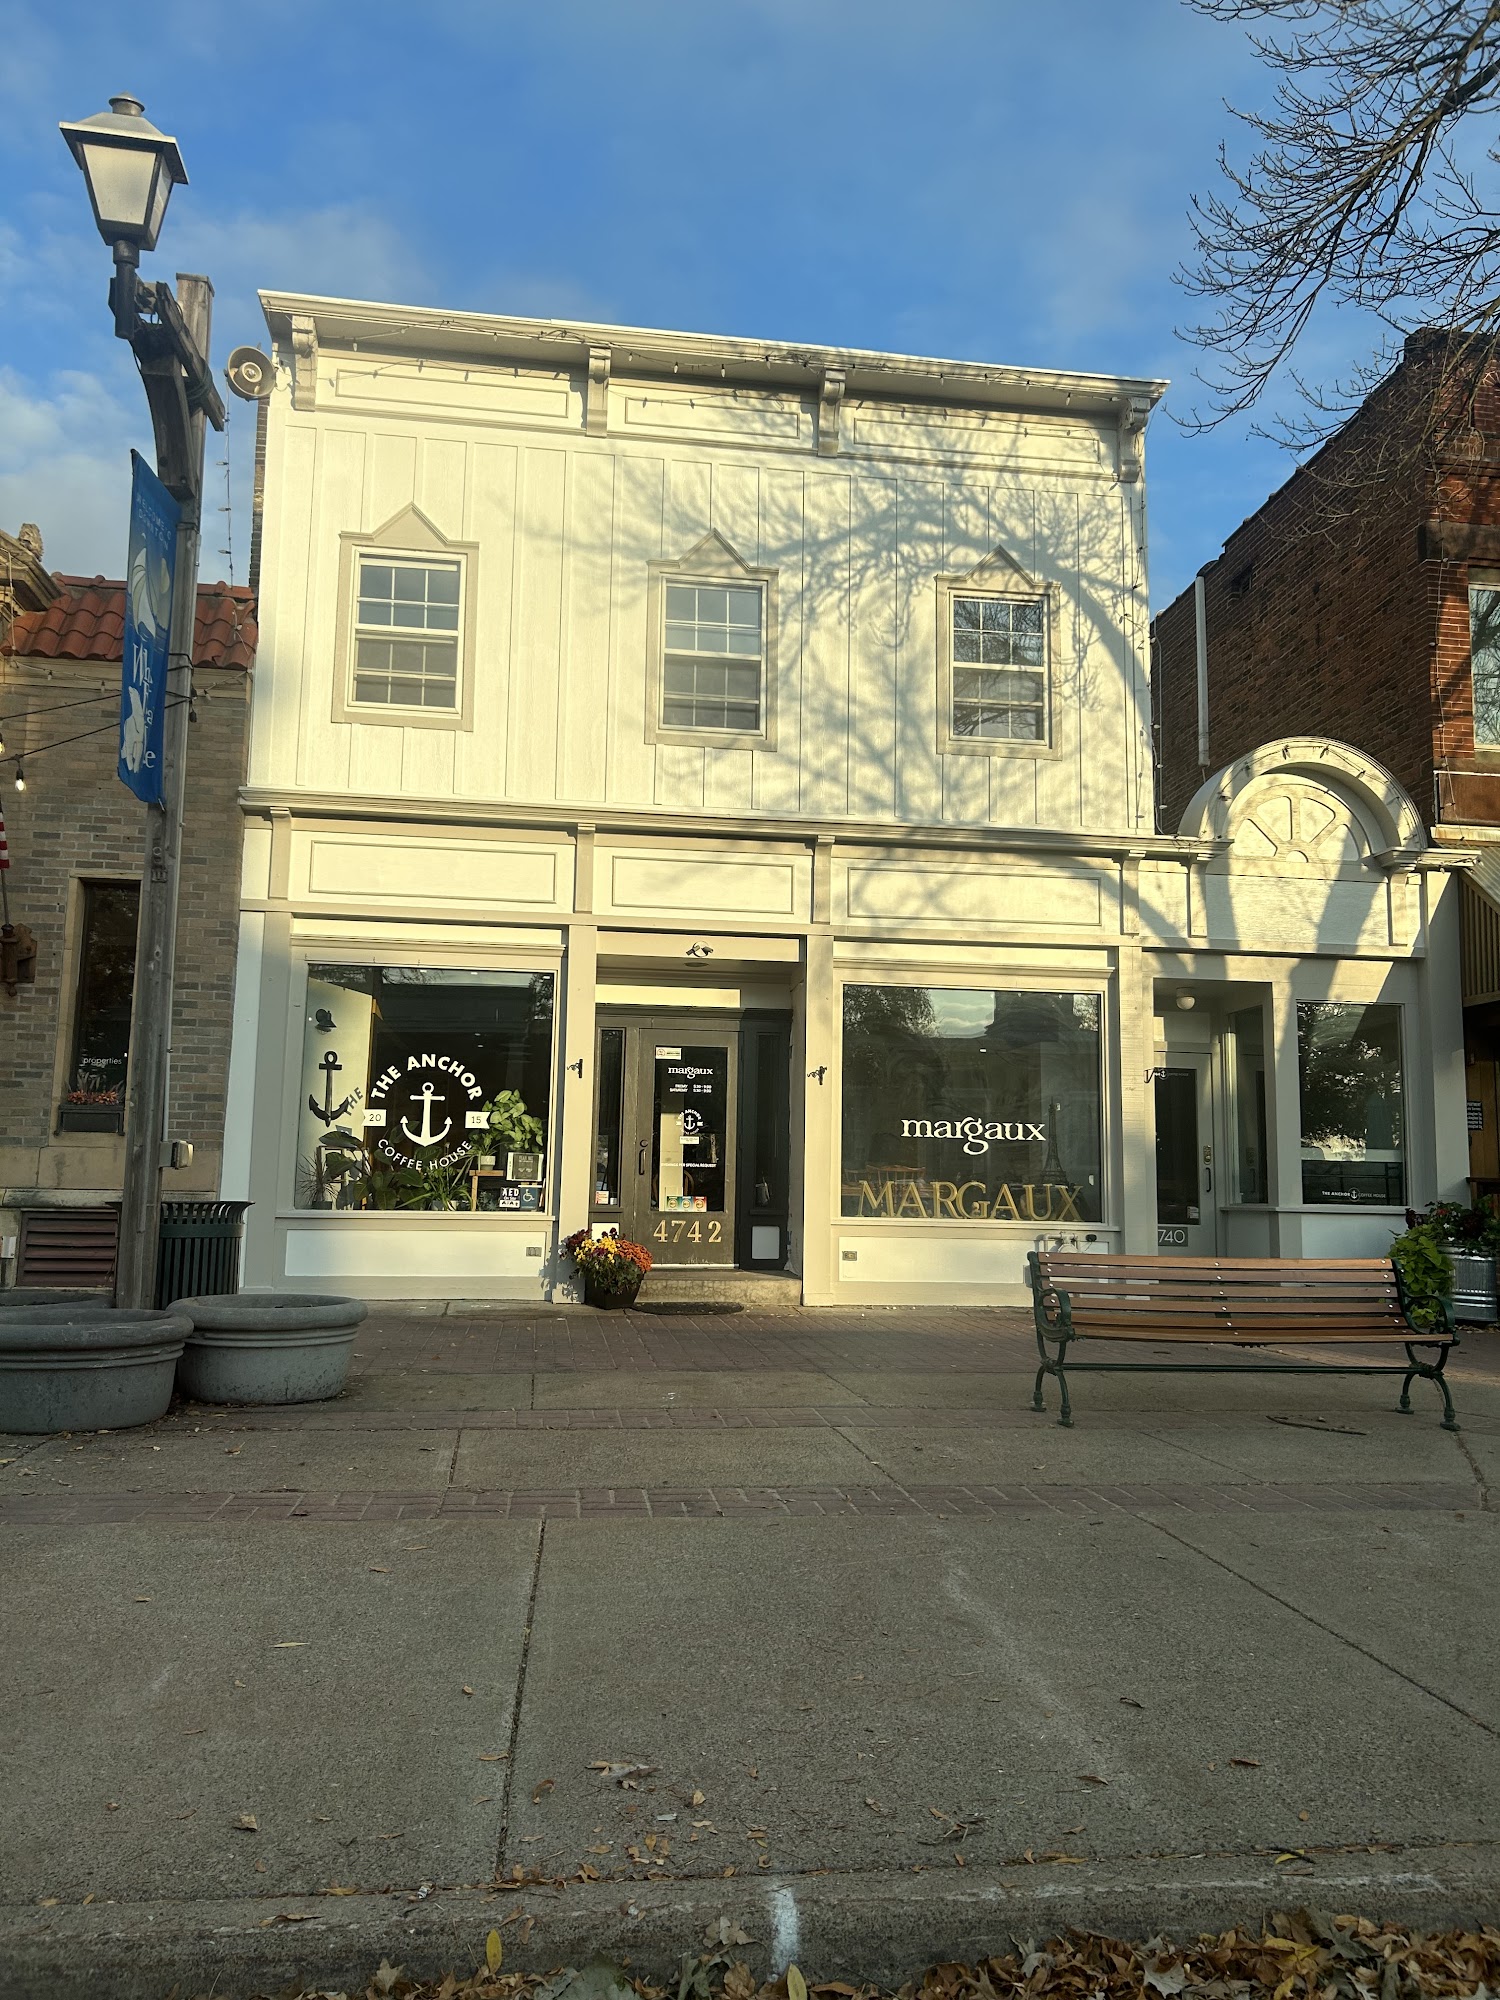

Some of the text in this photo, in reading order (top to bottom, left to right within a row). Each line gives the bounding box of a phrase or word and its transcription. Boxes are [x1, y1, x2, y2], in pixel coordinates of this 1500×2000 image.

[370, 1053, 483, 1101] THE ANCHOR
[667, 1066, 714, 1079] margaux
[368, 1113, 382, 1122] 20
[471, 1115, 482, 1124] 15
[900, 1117, 1046, 1155] margaux
[377, 1138, 472, 1171] COFFEE HOUSE
[502, 1187, 520, 1197] AED
[858, 1180, 1084, 1221] MARGAUX
[653, 1219, 722, 1244] 4742
